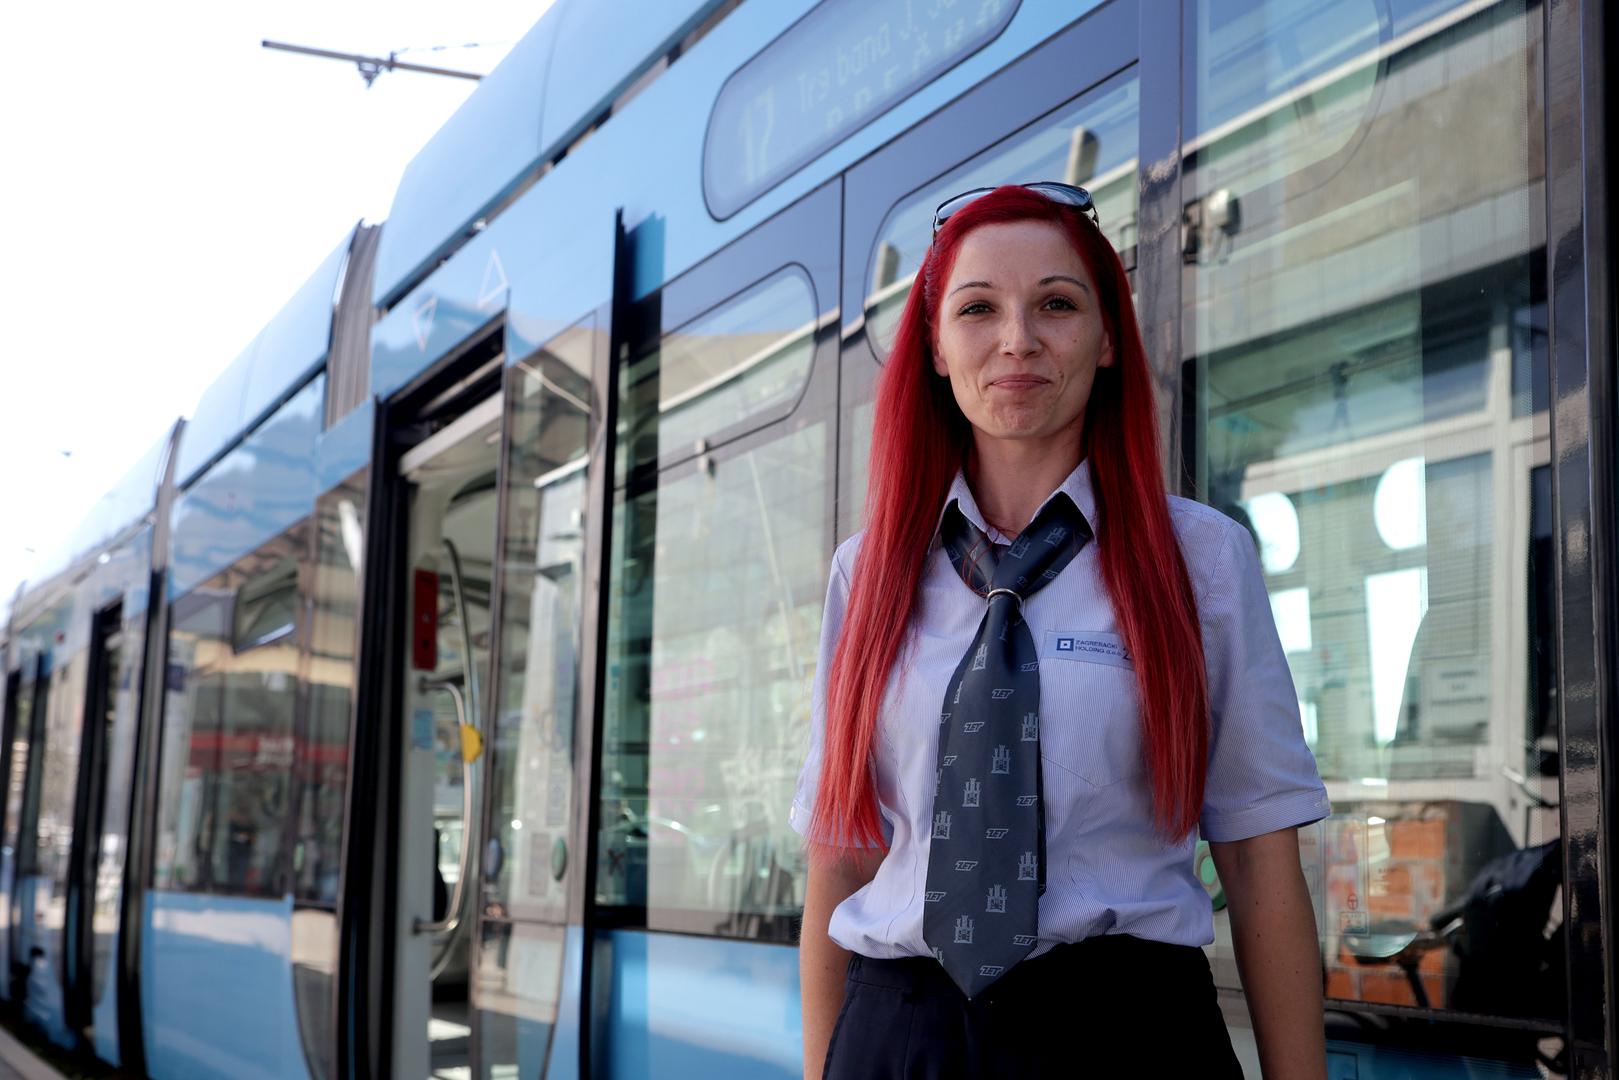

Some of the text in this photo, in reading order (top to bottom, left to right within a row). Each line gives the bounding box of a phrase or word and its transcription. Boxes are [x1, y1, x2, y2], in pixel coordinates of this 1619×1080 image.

[739, 84, 775, 185] 17
[1075, 645, 1105, 654] HOLDING
[992, 688, 1014, 699] ZET
[964, 721, 985, 733] ZET
[943, 755, 957, 766] ET
[1016, 795, 1037, 806] ZET
[986, 828, 1008, 839] ZET
[955, 860, 978, 871] ZET
[925, 891, 947, 902] ZET
[1012, 934, 1036, 946] ZET
[979, 965, 1003, 977] ZET
